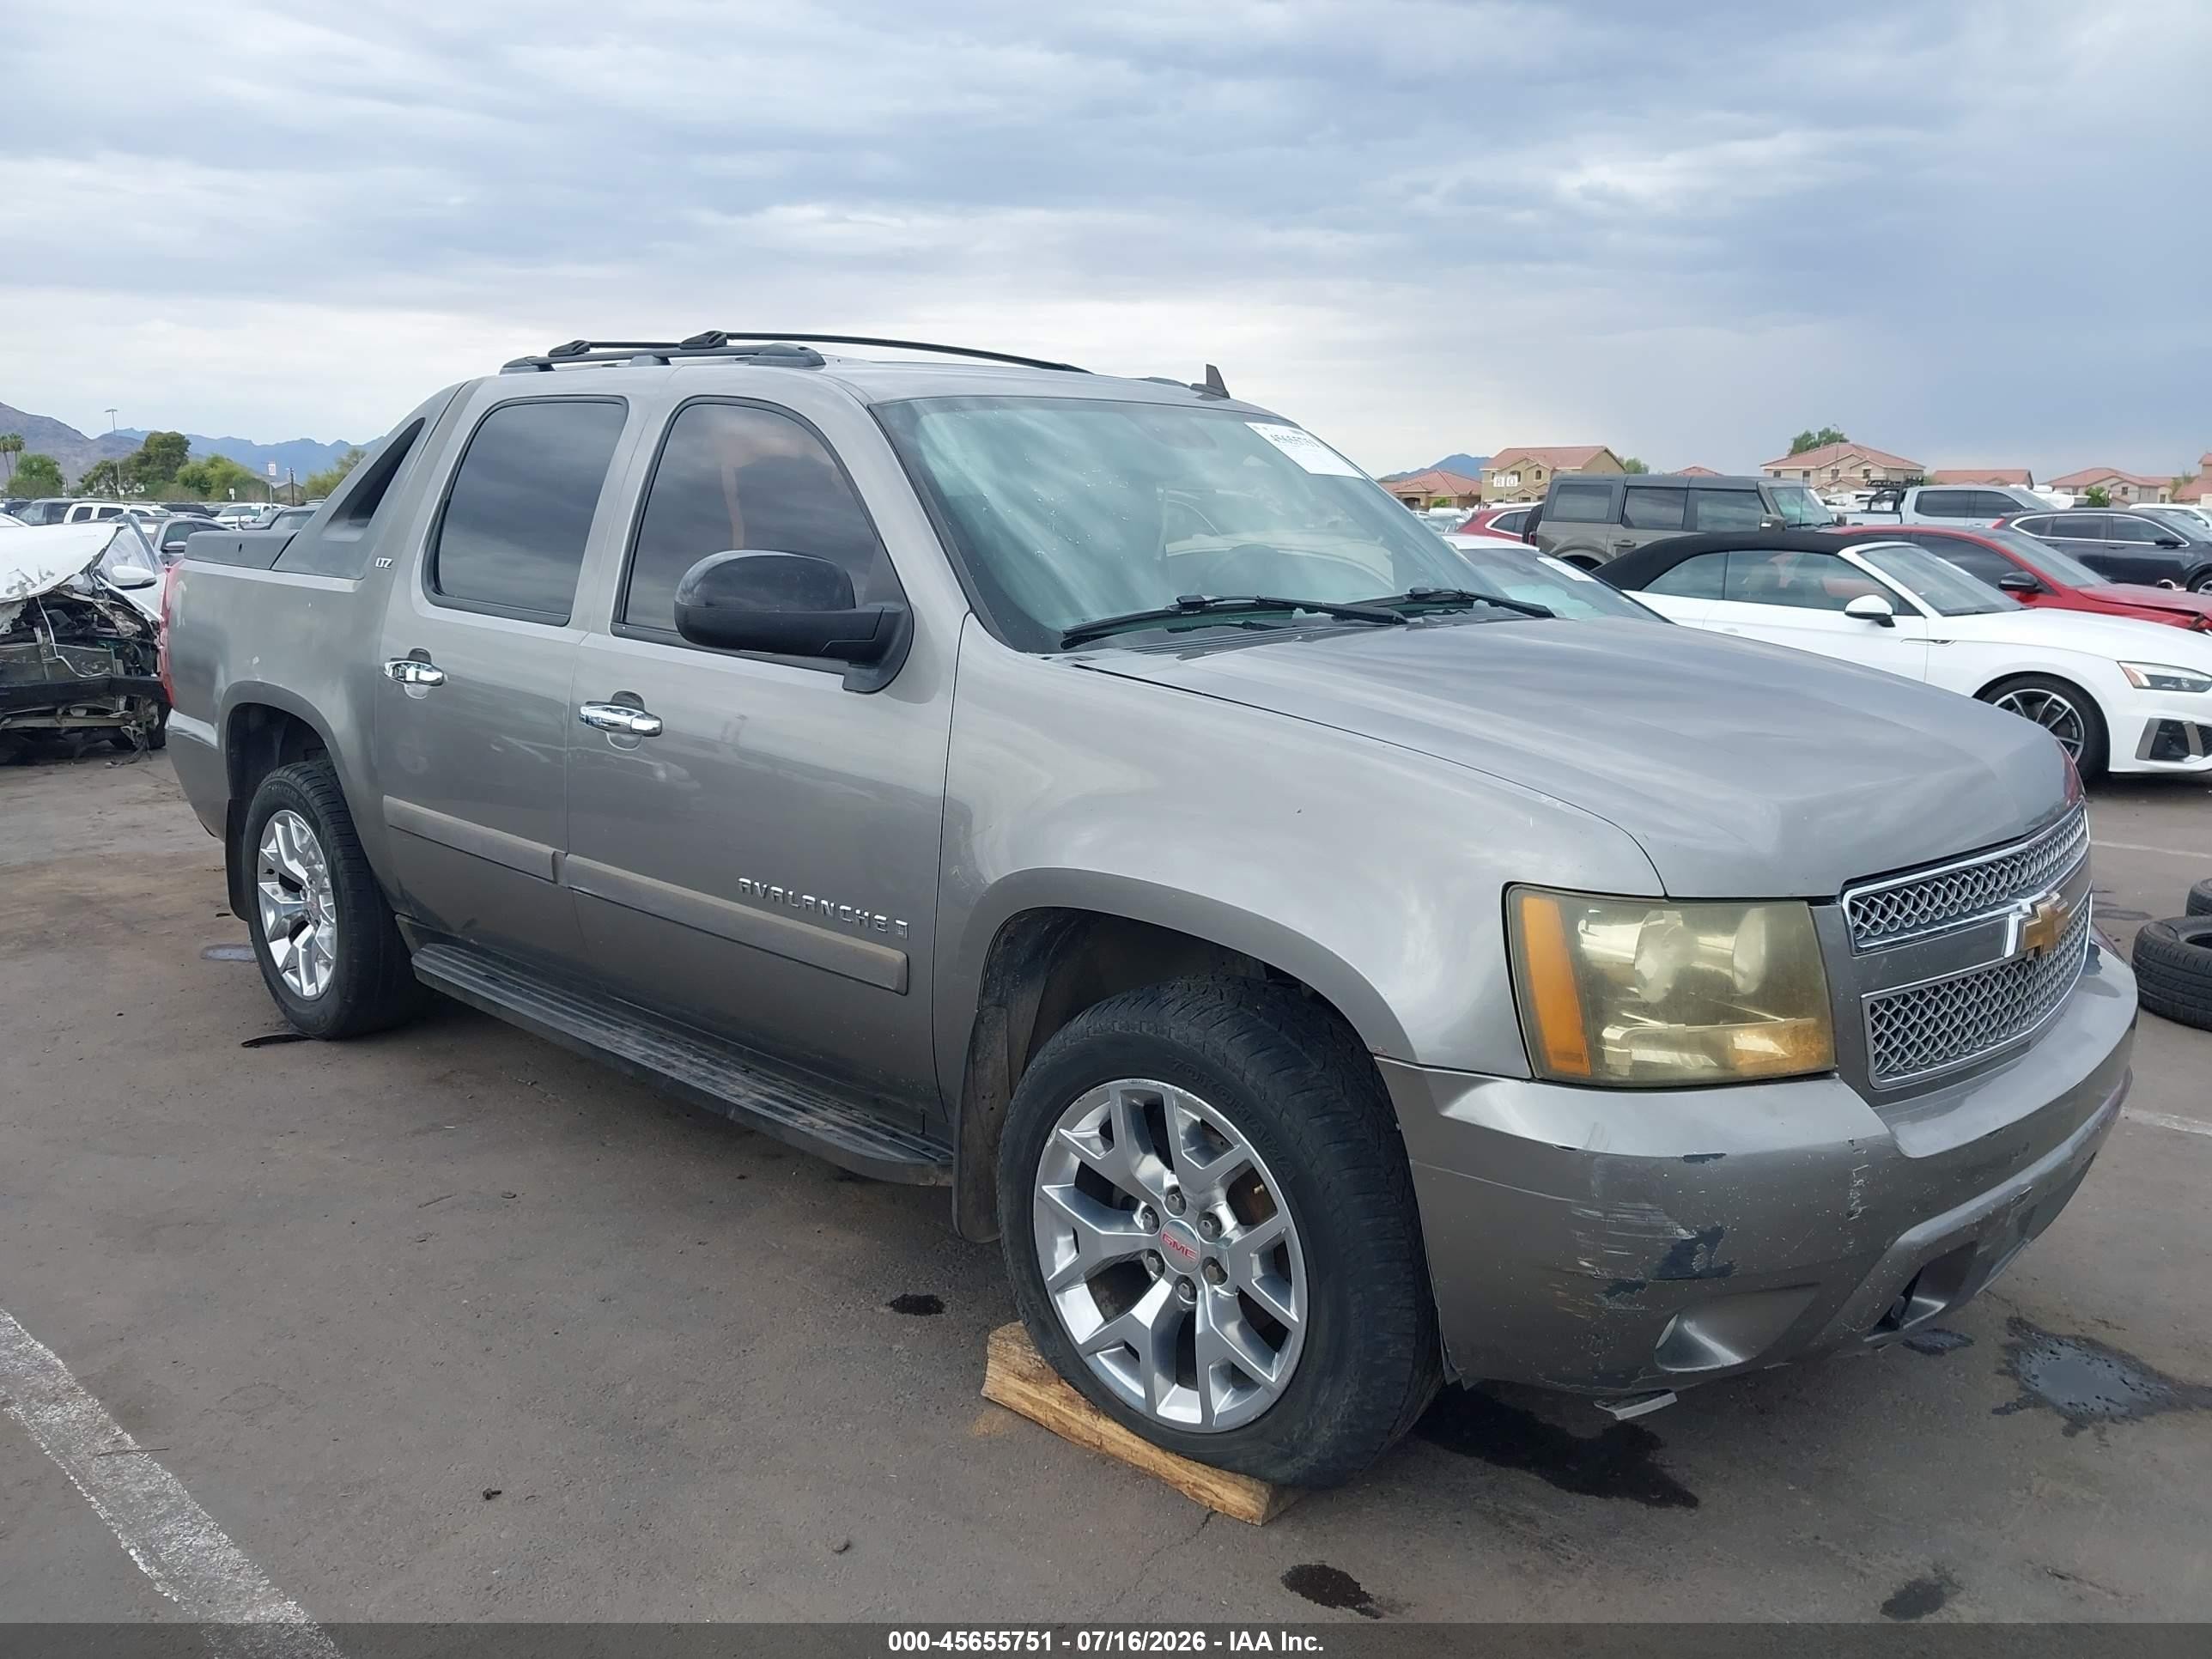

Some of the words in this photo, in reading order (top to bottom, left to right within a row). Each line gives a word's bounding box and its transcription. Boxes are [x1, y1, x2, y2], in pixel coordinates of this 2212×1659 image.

[375, 557, 392, 568] LTZ
[738, 877, 888, 933] AVALANCHE
[1162, 1232, 1198, 1261] GMC
